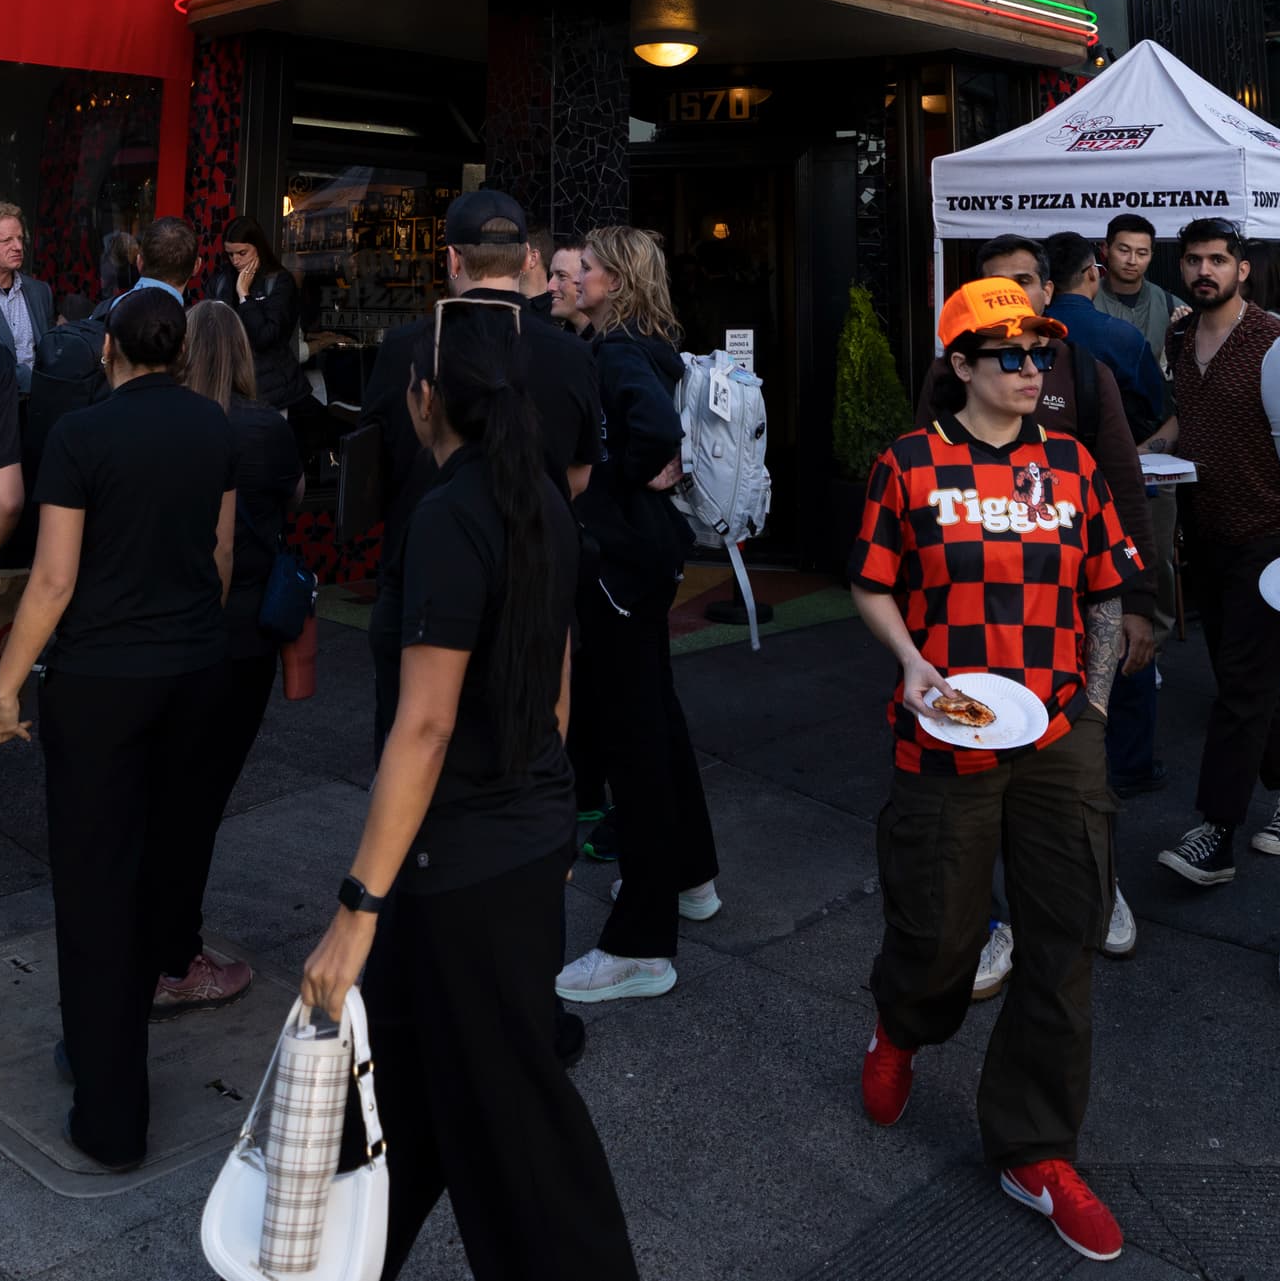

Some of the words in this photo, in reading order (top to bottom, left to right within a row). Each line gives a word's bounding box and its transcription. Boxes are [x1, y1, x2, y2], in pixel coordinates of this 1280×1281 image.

[665, 88, 751, 122] 1570
[1083, 130, 1150, 140] TONY'S
[1077, 140, 1139, 150] PIZZA
[946, 195, 1014, 211] TONY'S
[1018, 193, 1075, 210] PIZZA
[1080, 190, 1230, 209] NAPOLETANA
[984, 294, 1031, 310] 7-ELEV
